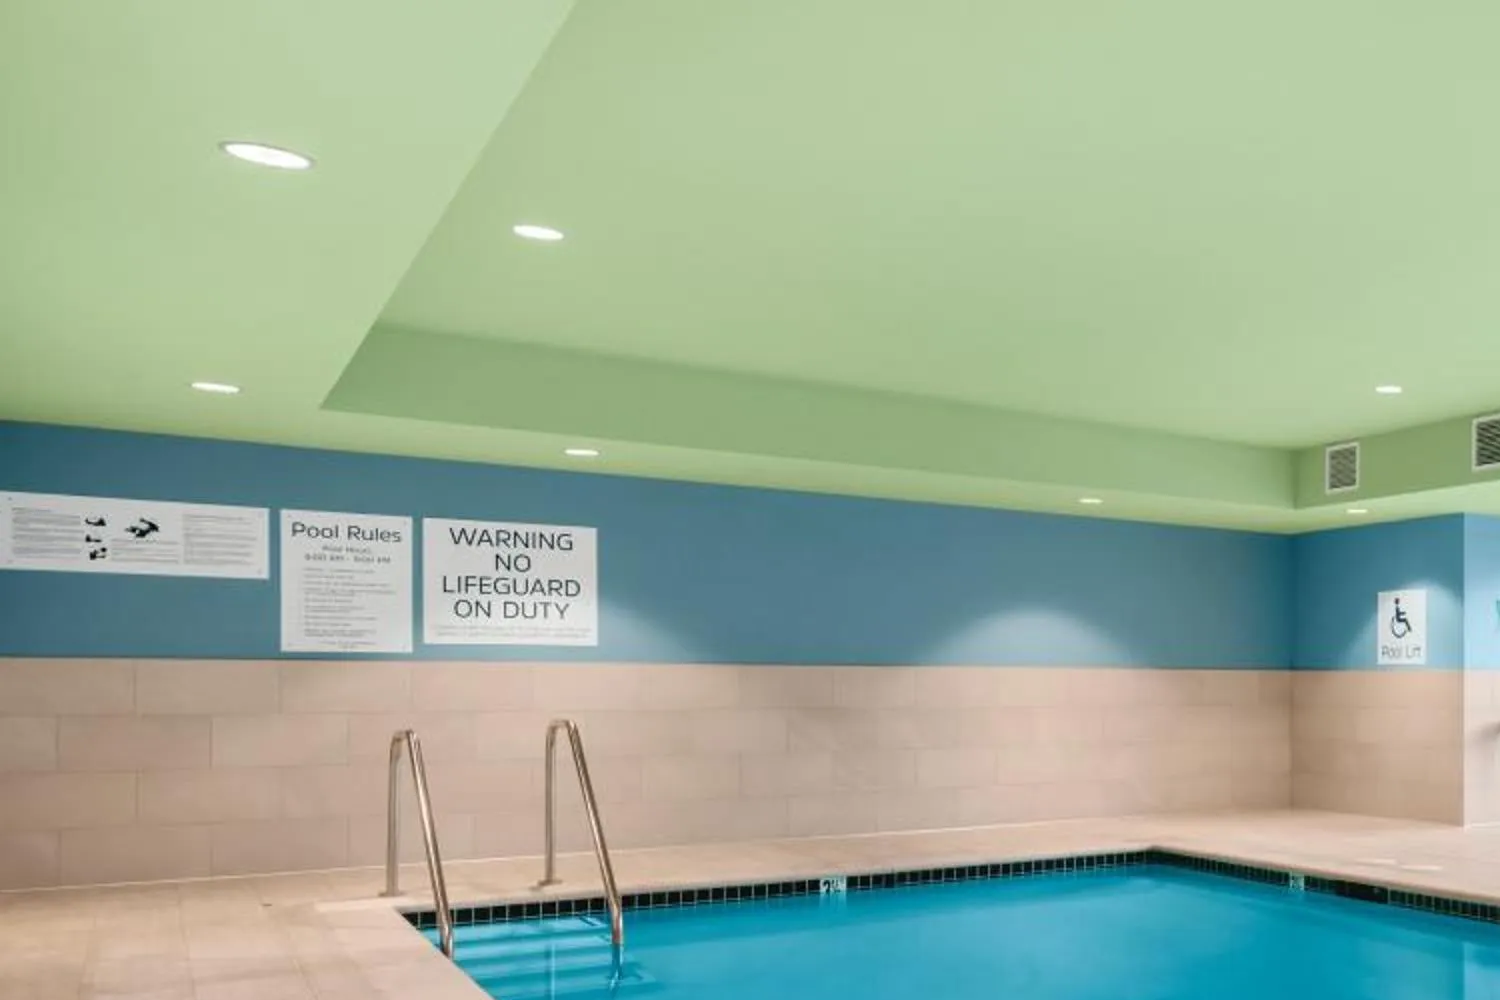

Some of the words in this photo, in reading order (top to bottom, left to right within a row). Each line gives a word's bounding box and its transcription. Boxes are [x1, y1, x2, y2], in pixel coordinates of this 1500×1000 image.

[291, 521, 339, 539] Pool
[347, 525, 402, 542] Rules
[449, 527, 573, 551] WARNING
[495, 553, 531, 573] NO
[443, 575, 581, 597] LIFEGUARD
[453, 599, 492, 618] ON
[503, 601, 570, 619] DUTY
[1381, 645, 1401, 659] Pool
[1405, 644, 1421, 658] Lift
